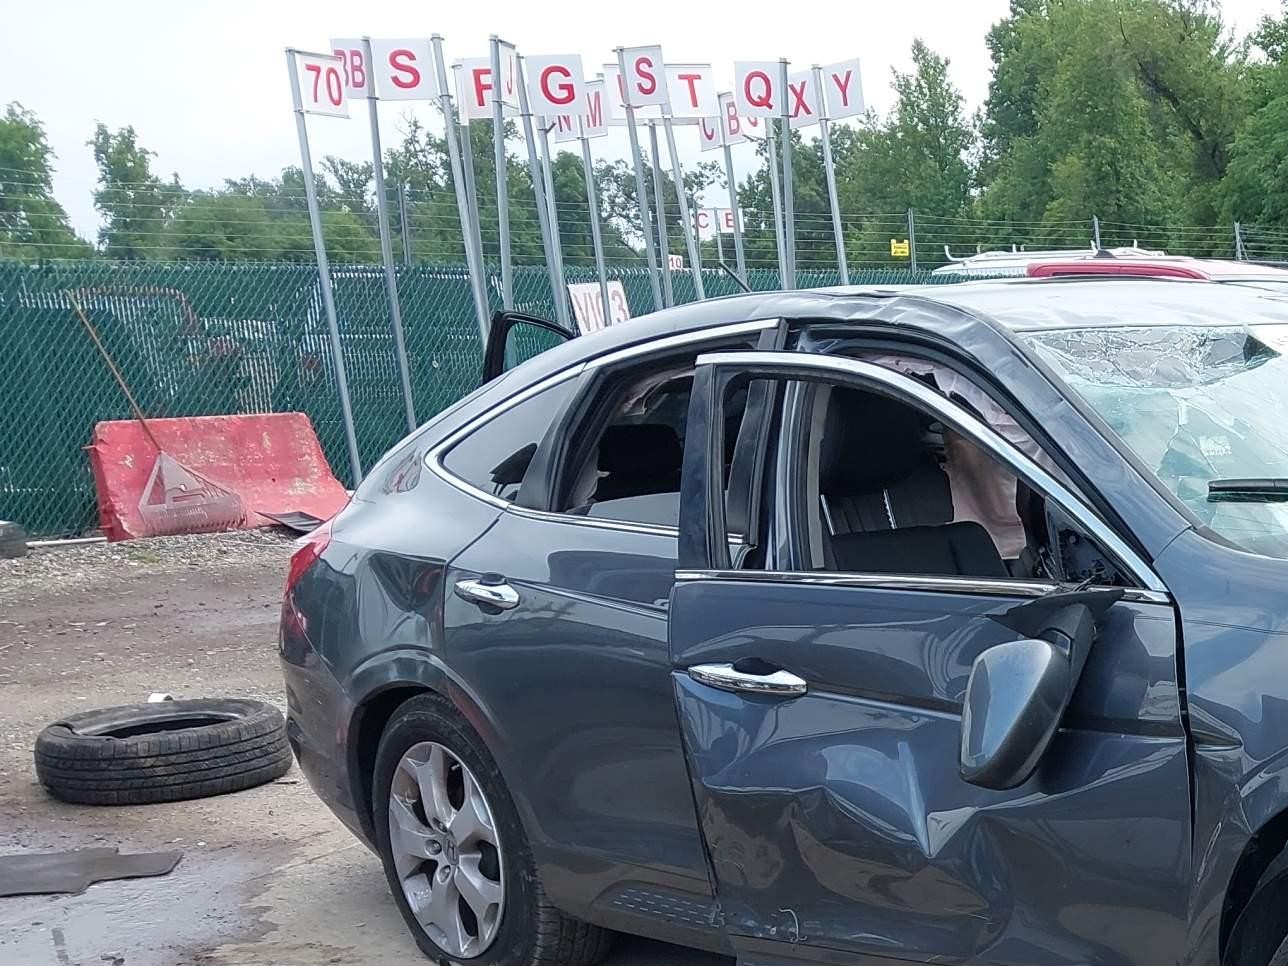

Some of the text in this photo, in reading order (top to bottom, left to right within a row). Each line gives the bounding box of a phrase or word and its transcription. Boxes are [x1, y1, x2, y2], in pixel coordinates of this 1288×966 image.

[305, 63, 342, 106] 70
[389, 49, 420, 89] S
[472, 68, 493, 107] F
[540, 65, 576, 105] G
[635, 56, 657, 96] S
[832, 70, 852, 107] Y
[677, 74, 702, 108] T
[744, 70, 774, 110] Q
[788, 80, 812, 118] X
[725, 101, 740, 135] B
